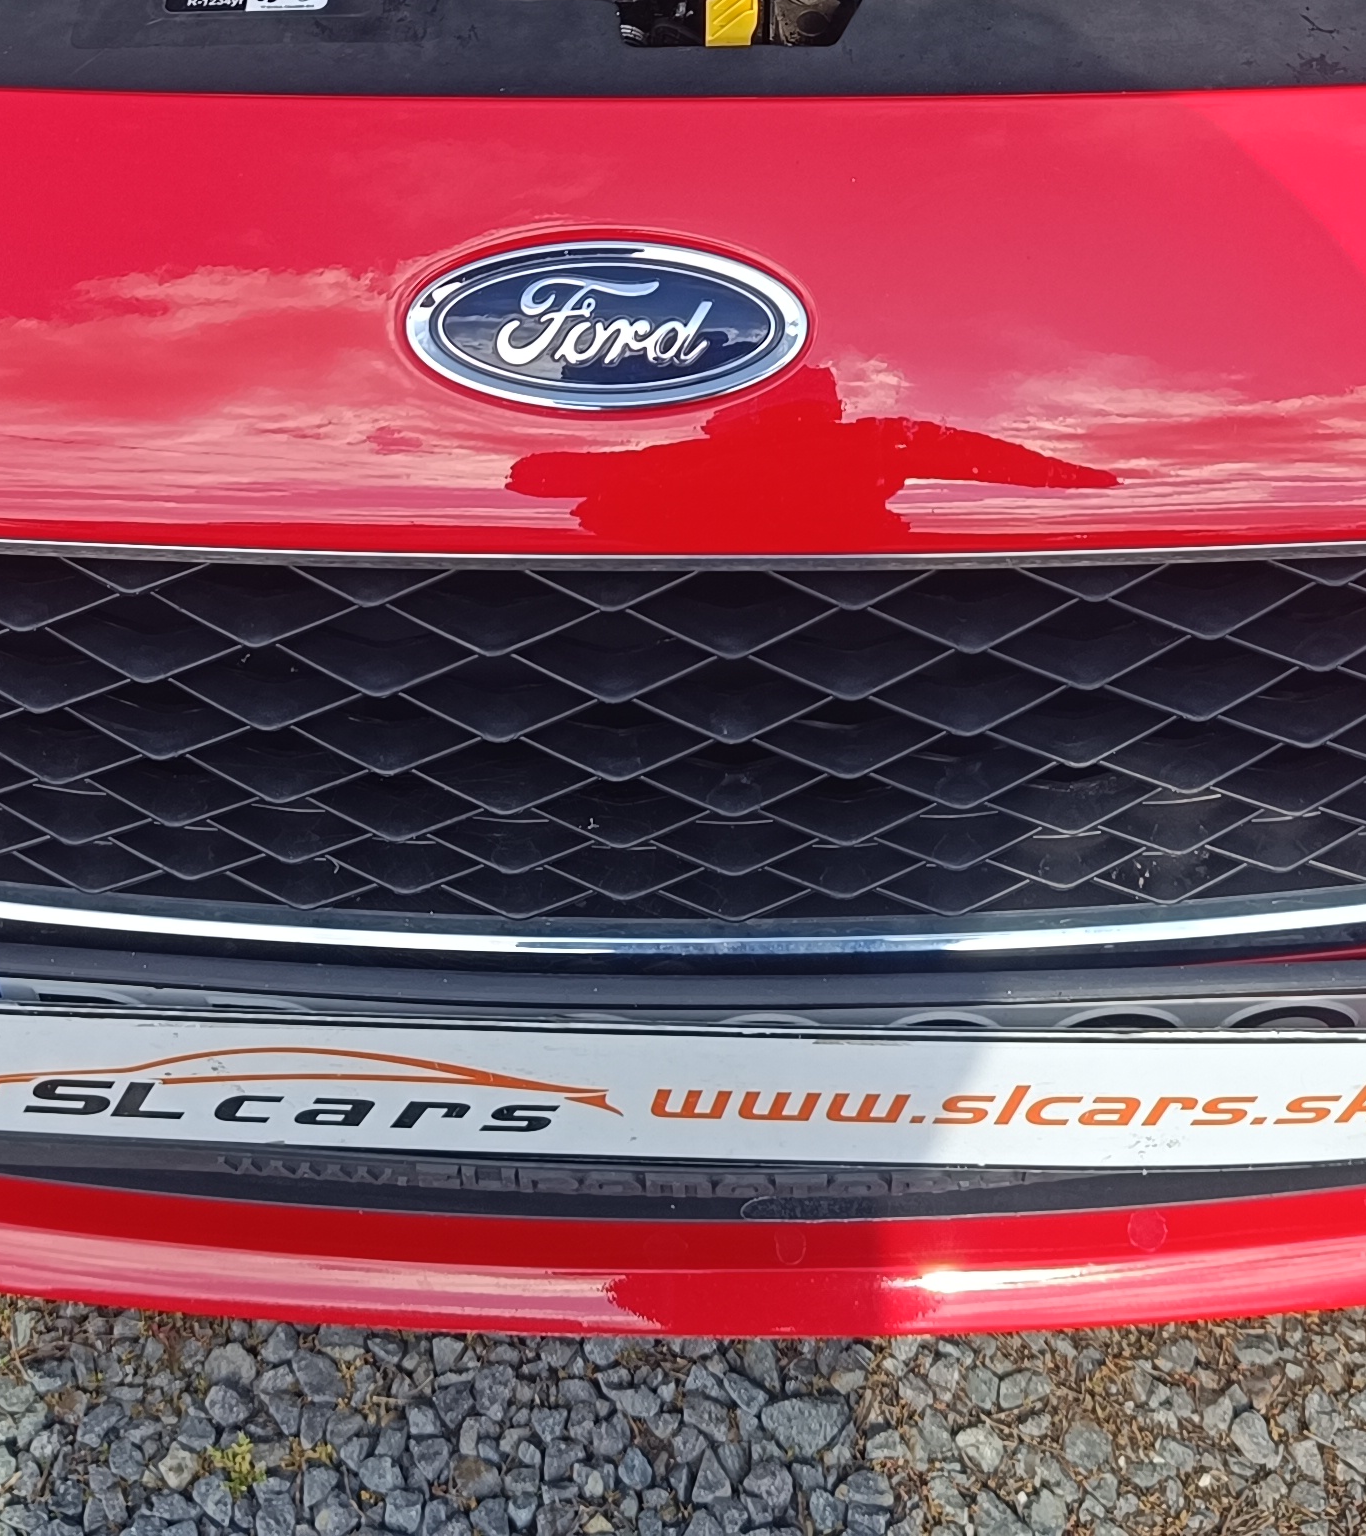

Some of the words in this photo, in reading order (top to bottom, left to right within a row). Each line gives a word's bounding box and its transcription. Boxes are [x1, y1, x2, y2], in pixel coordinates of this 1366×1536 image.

[496, 277, 715, 366] Ford
[23, 1078, 186, 1120] SL
[213, 1094, 561, 1132] cars
